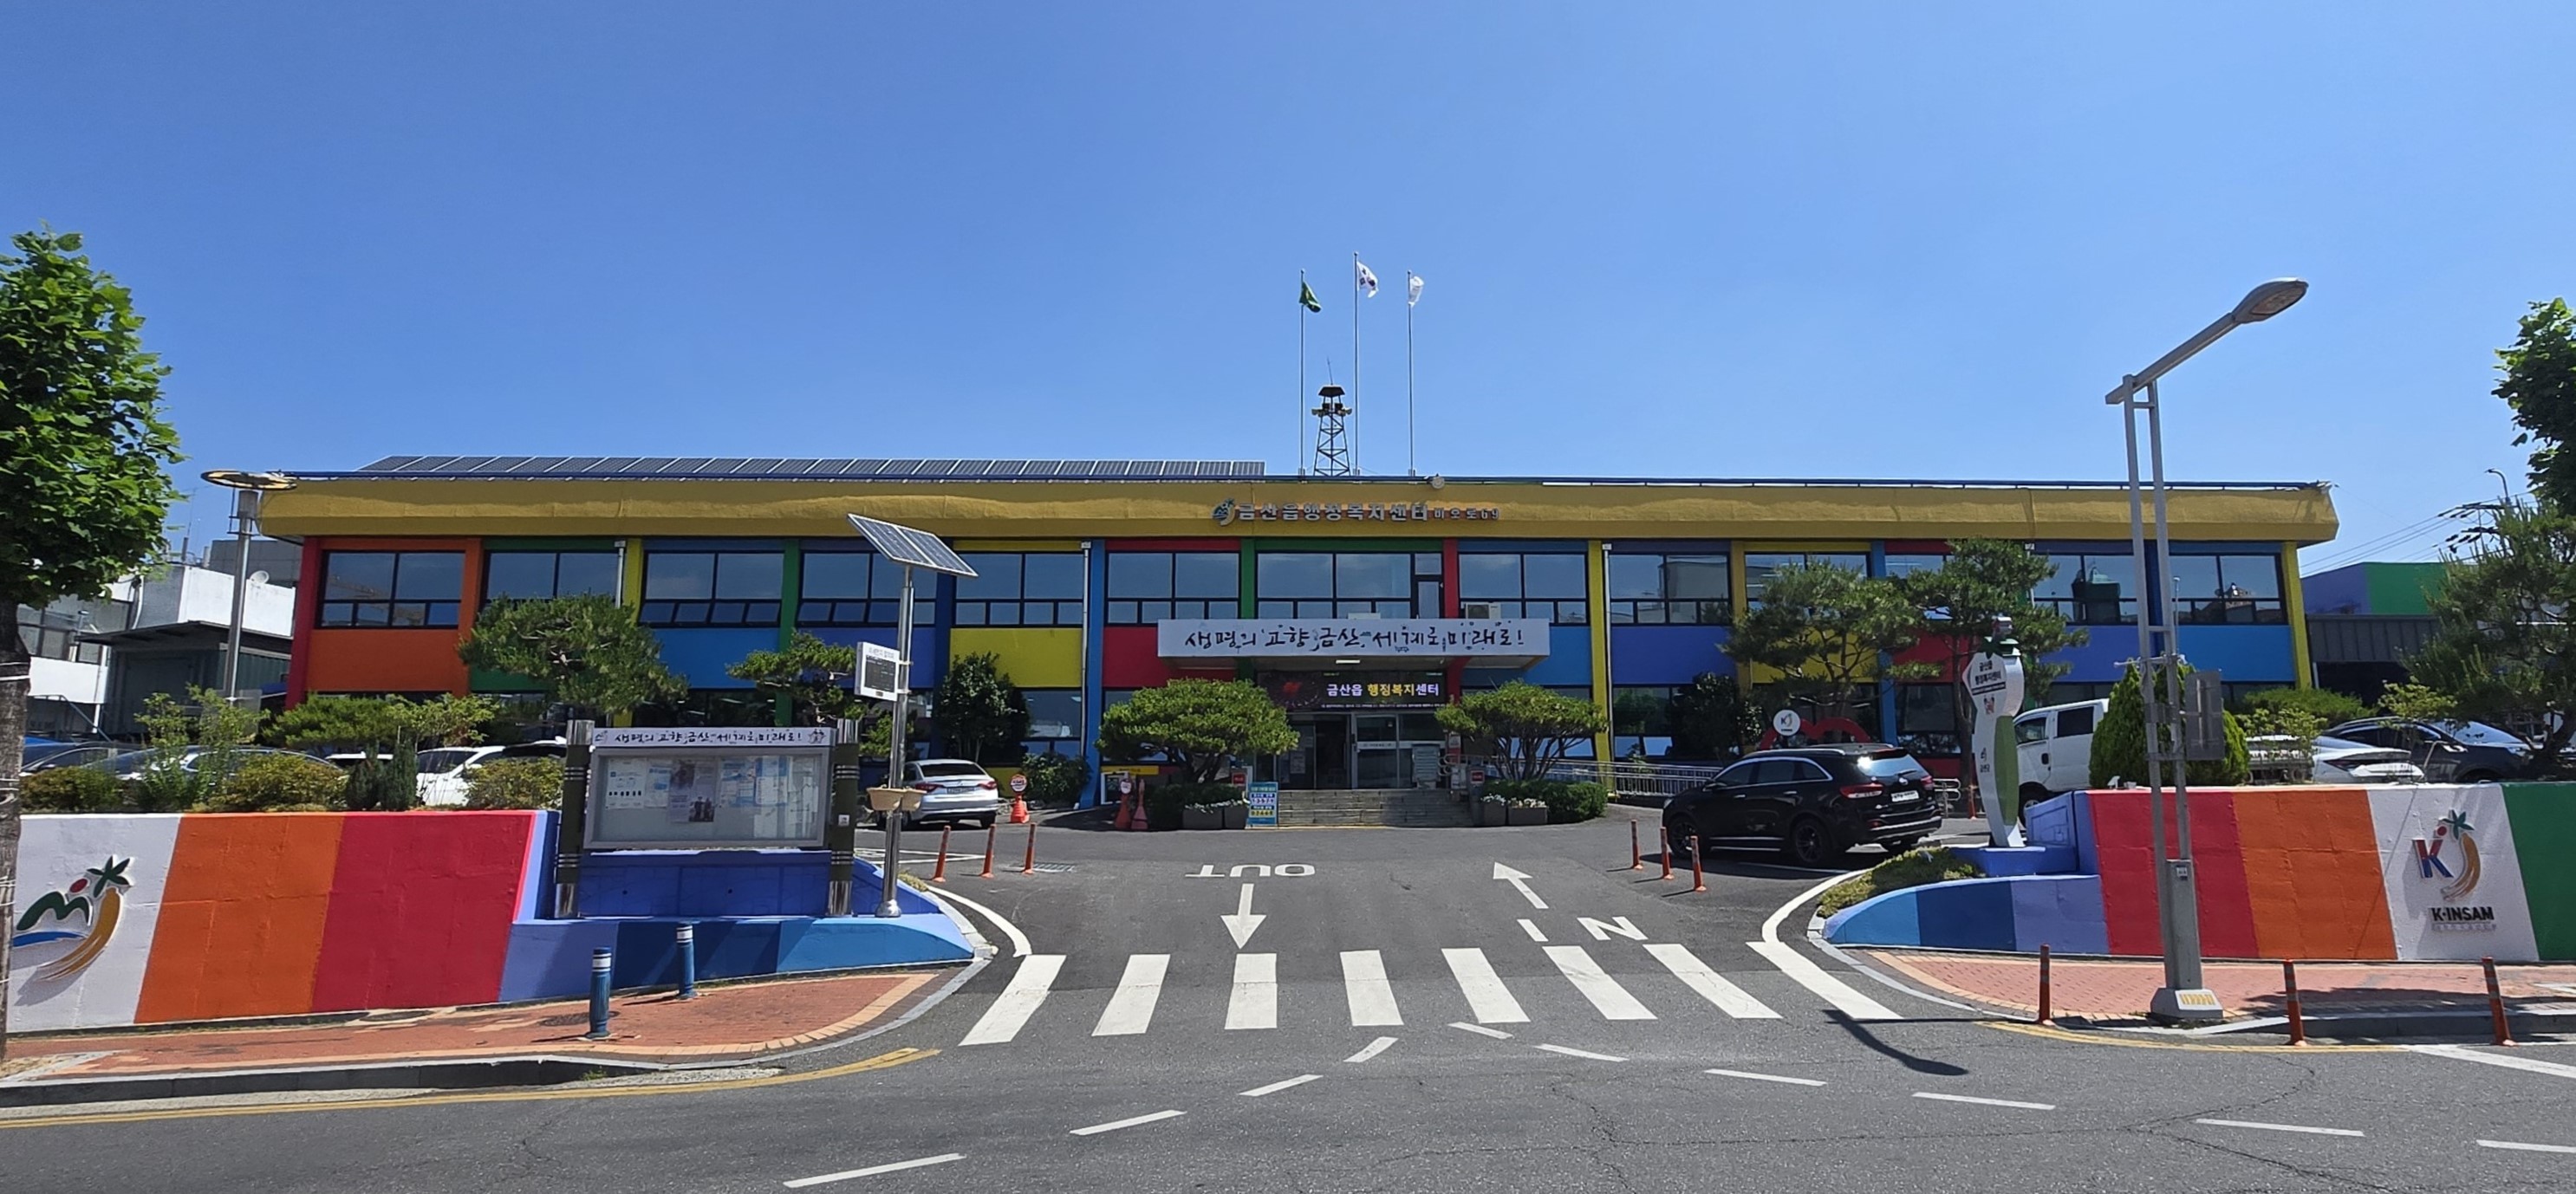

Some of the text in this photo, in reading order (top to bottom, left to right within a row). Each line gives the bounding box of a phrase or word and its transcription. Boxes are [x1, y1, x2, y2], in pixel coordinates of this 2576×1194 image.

[1239, 503, 1428, 521] 금산읍행정복지센터
[1185, 630, 1256, 649] 생명의
[1372, 626, 1439, 648] 세계로
[1327, 683, 1439, 697] 금산읍 행정복지센터
[1185, 863, 1315, 877] OUT
[1517, 916, 1649, 942] IN
